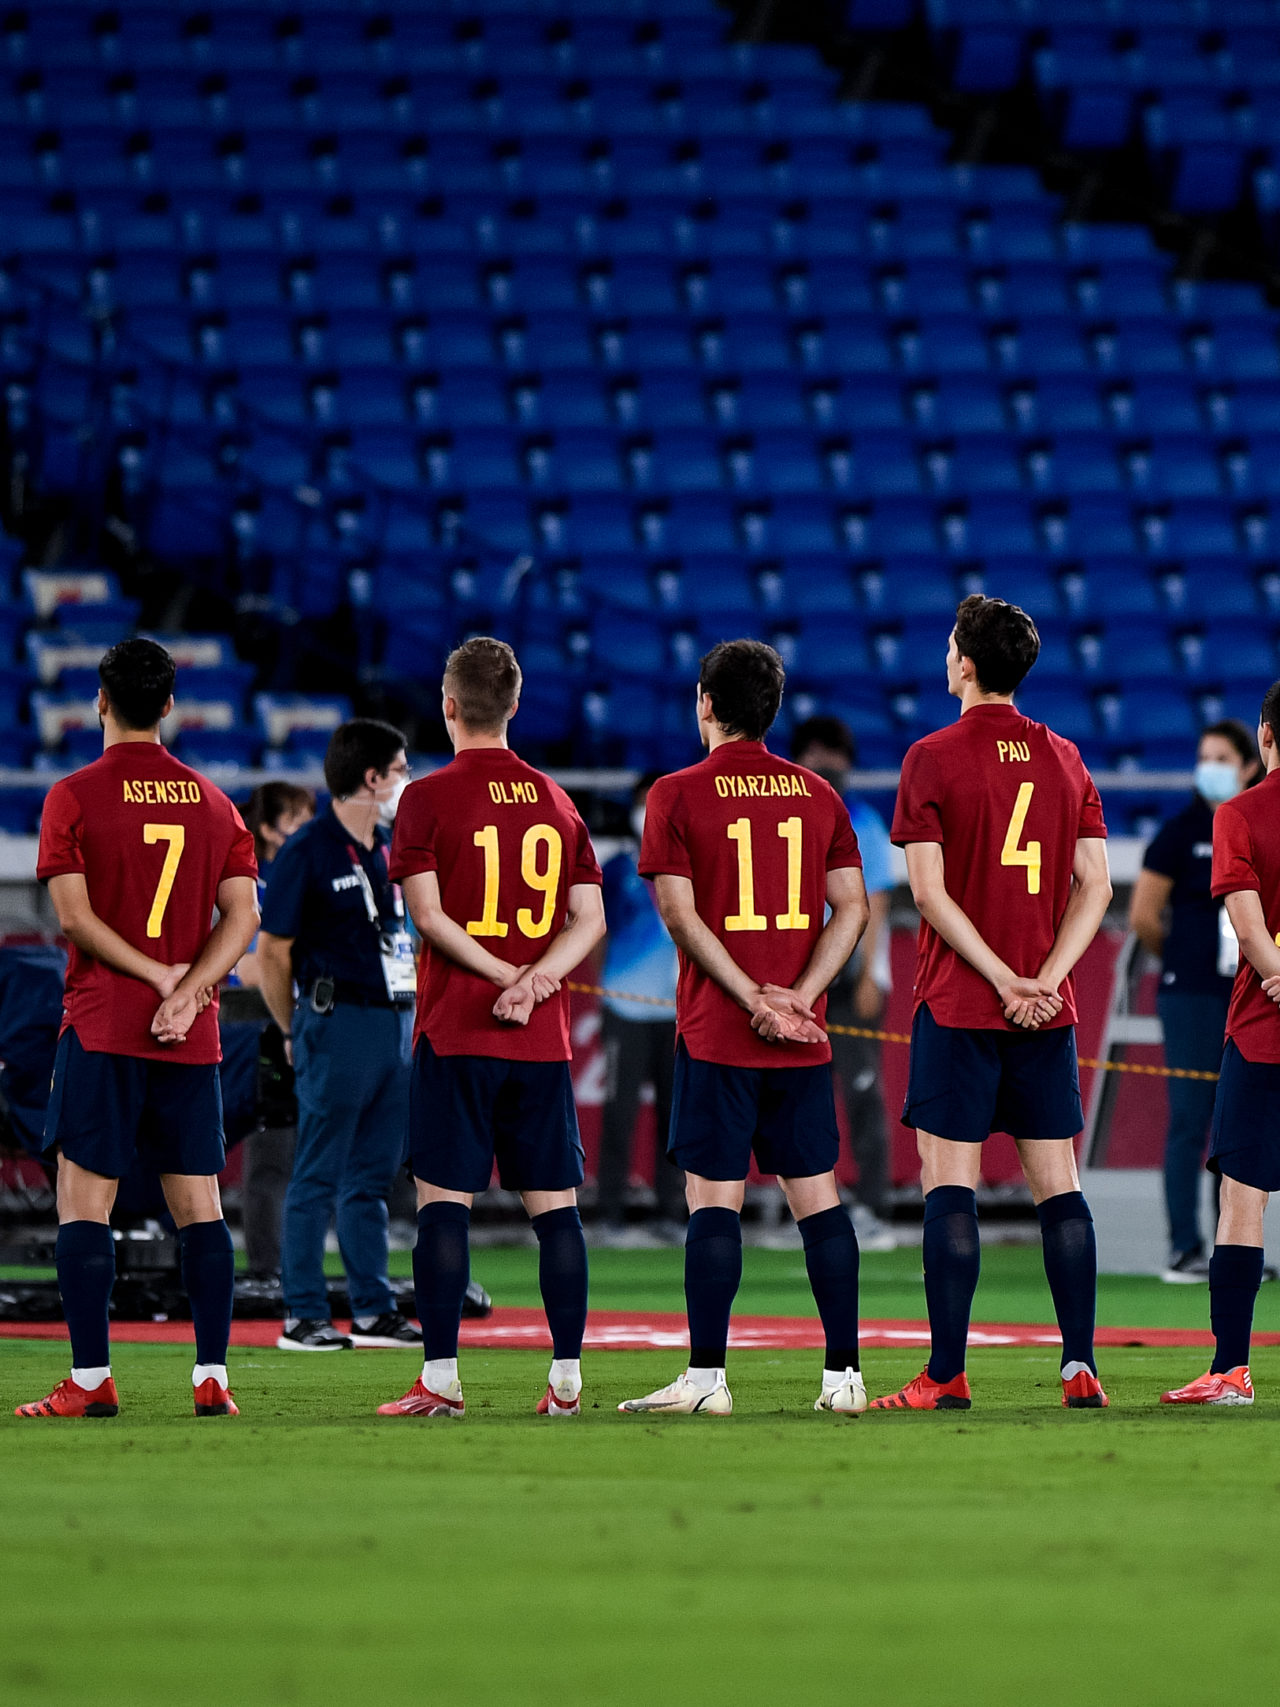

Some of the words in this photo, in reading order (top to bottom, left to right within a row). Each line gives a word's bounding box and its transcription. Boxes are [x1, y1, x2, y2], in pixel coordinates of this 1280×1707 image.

[714, 774, 812, 798] OYARZABAL
[996, 740, 1031, 763] PAU
[122, 780, 201, 805] ASENSIO
[488, 781, 539, 805] OLMO
[1001, 782, 1042, 895] 4
[143, 823, 185, 938] 7
[466, 823, 562, 939] 19
[724, 816, 810, 932] 11
